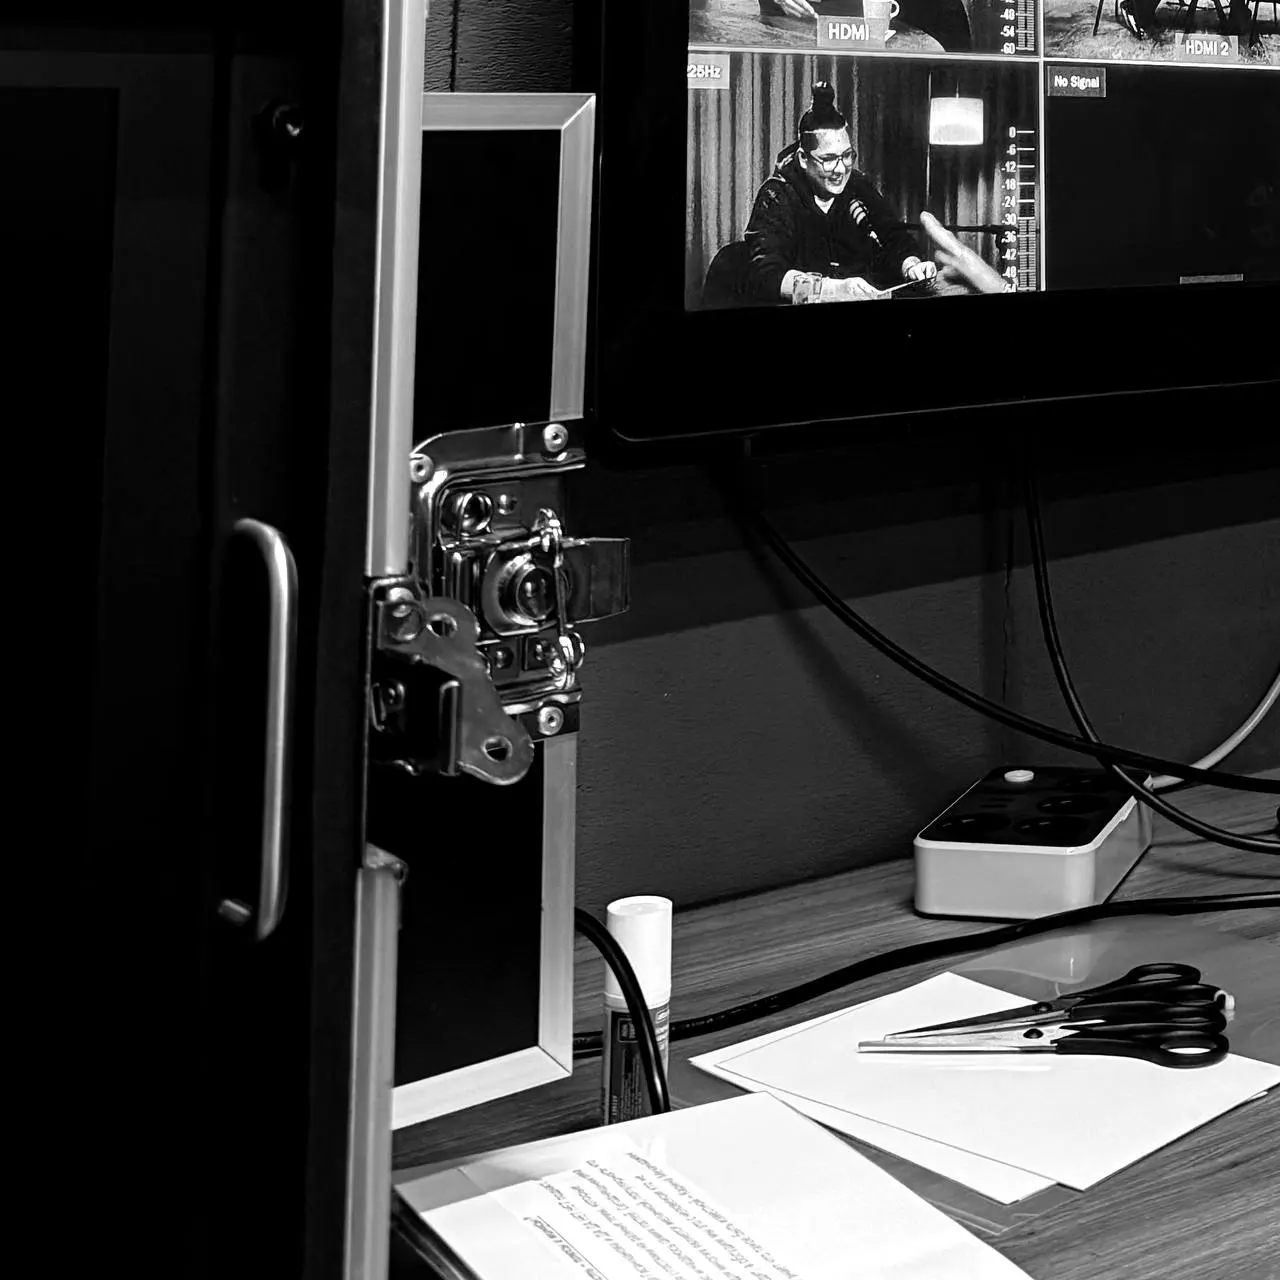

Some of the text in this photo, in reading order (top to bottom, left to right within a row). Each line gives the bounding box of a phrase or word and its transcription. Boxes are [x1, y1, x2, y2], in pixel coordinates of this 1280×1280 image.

[828, 22, 870, 41] HDMI
[1186, 39, 1230, 56] HDMI 2
[1054, 75, 1099, 90] No Signal
[1009, 126, 1016, 138] 0
[1006, 144, 1016, 155] -6
[1001, 161, 1016, 173] -12
[1001, 179, 1016, 190] -18
[1002, 196, 1016, 207] -24
[1002, 213, 1016, 225] -30
